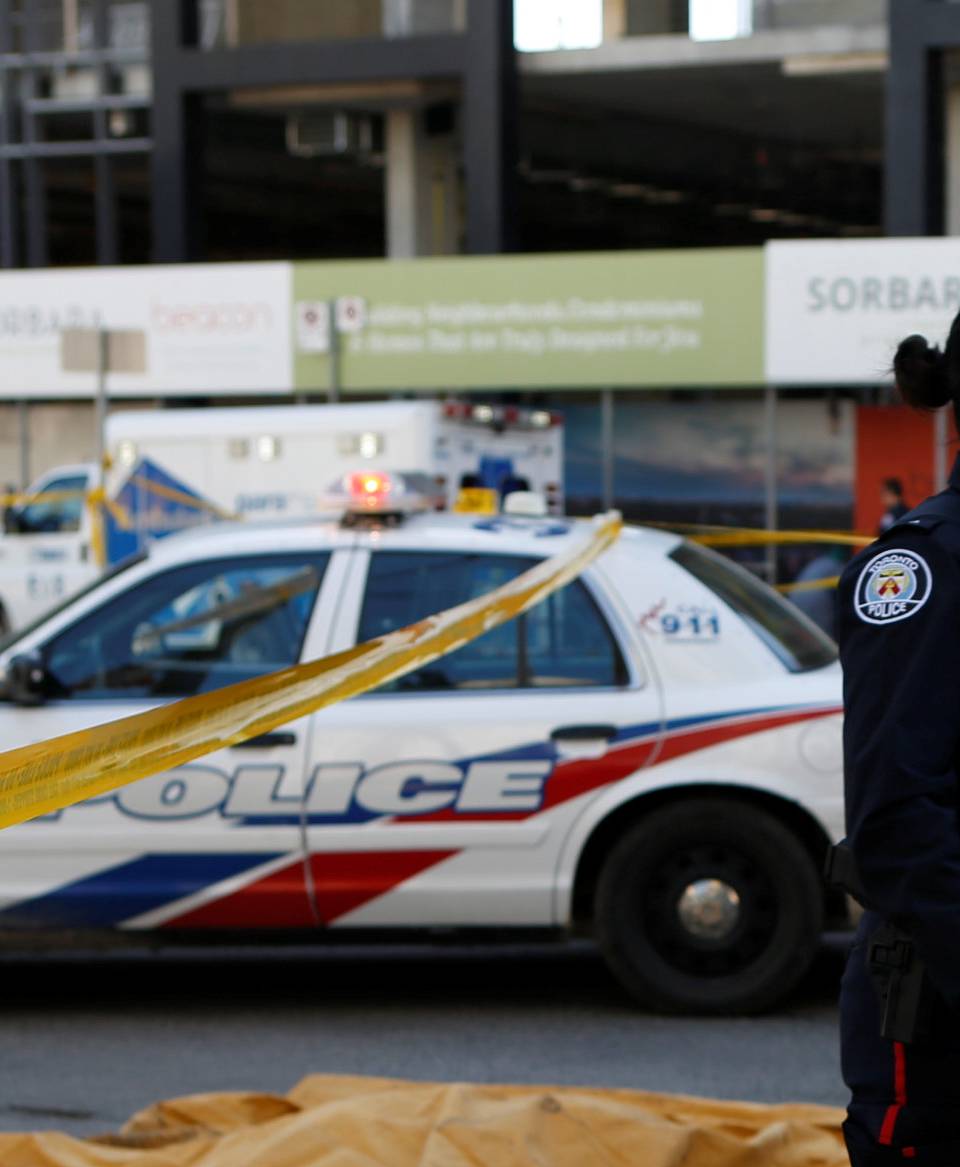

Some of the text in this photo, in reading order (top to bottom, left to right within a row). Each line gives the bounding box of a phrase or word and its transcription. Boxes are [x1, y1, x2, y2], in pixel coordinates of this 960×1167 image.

[868, 554, 919, 573] TORONTO
[867, 602, 907, 618] POLICE
[661, 614, 719, 635] 911
[24, 760, 553, 823] OLICE
